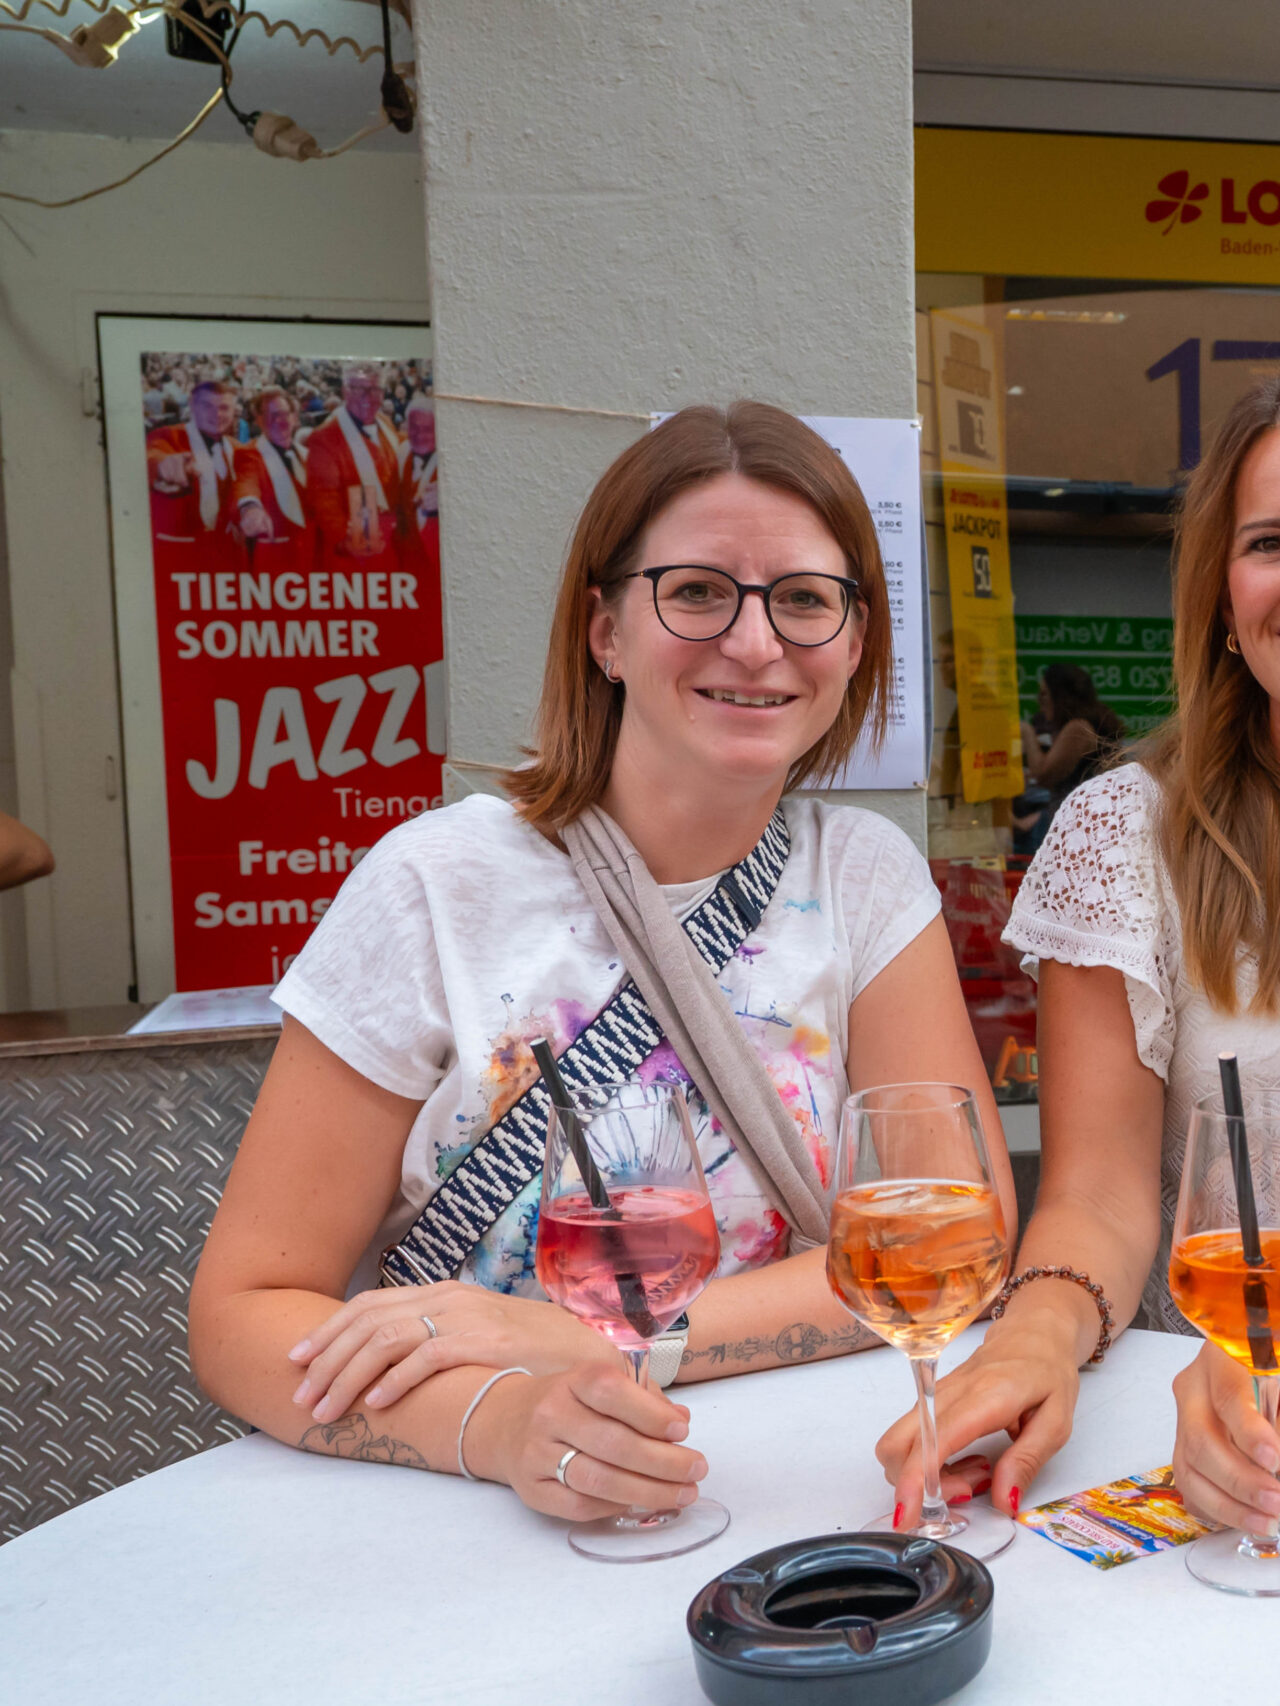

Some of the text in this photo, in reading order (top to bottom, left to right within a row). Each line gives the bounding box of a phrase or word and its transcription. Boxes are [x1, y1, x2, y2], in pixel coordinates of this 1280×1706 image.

[952, 512, 1001, 540] JACKPOT
[171, 571, 419, 611] TIENGENER
[175, 619, 380, 659] SOMMER
